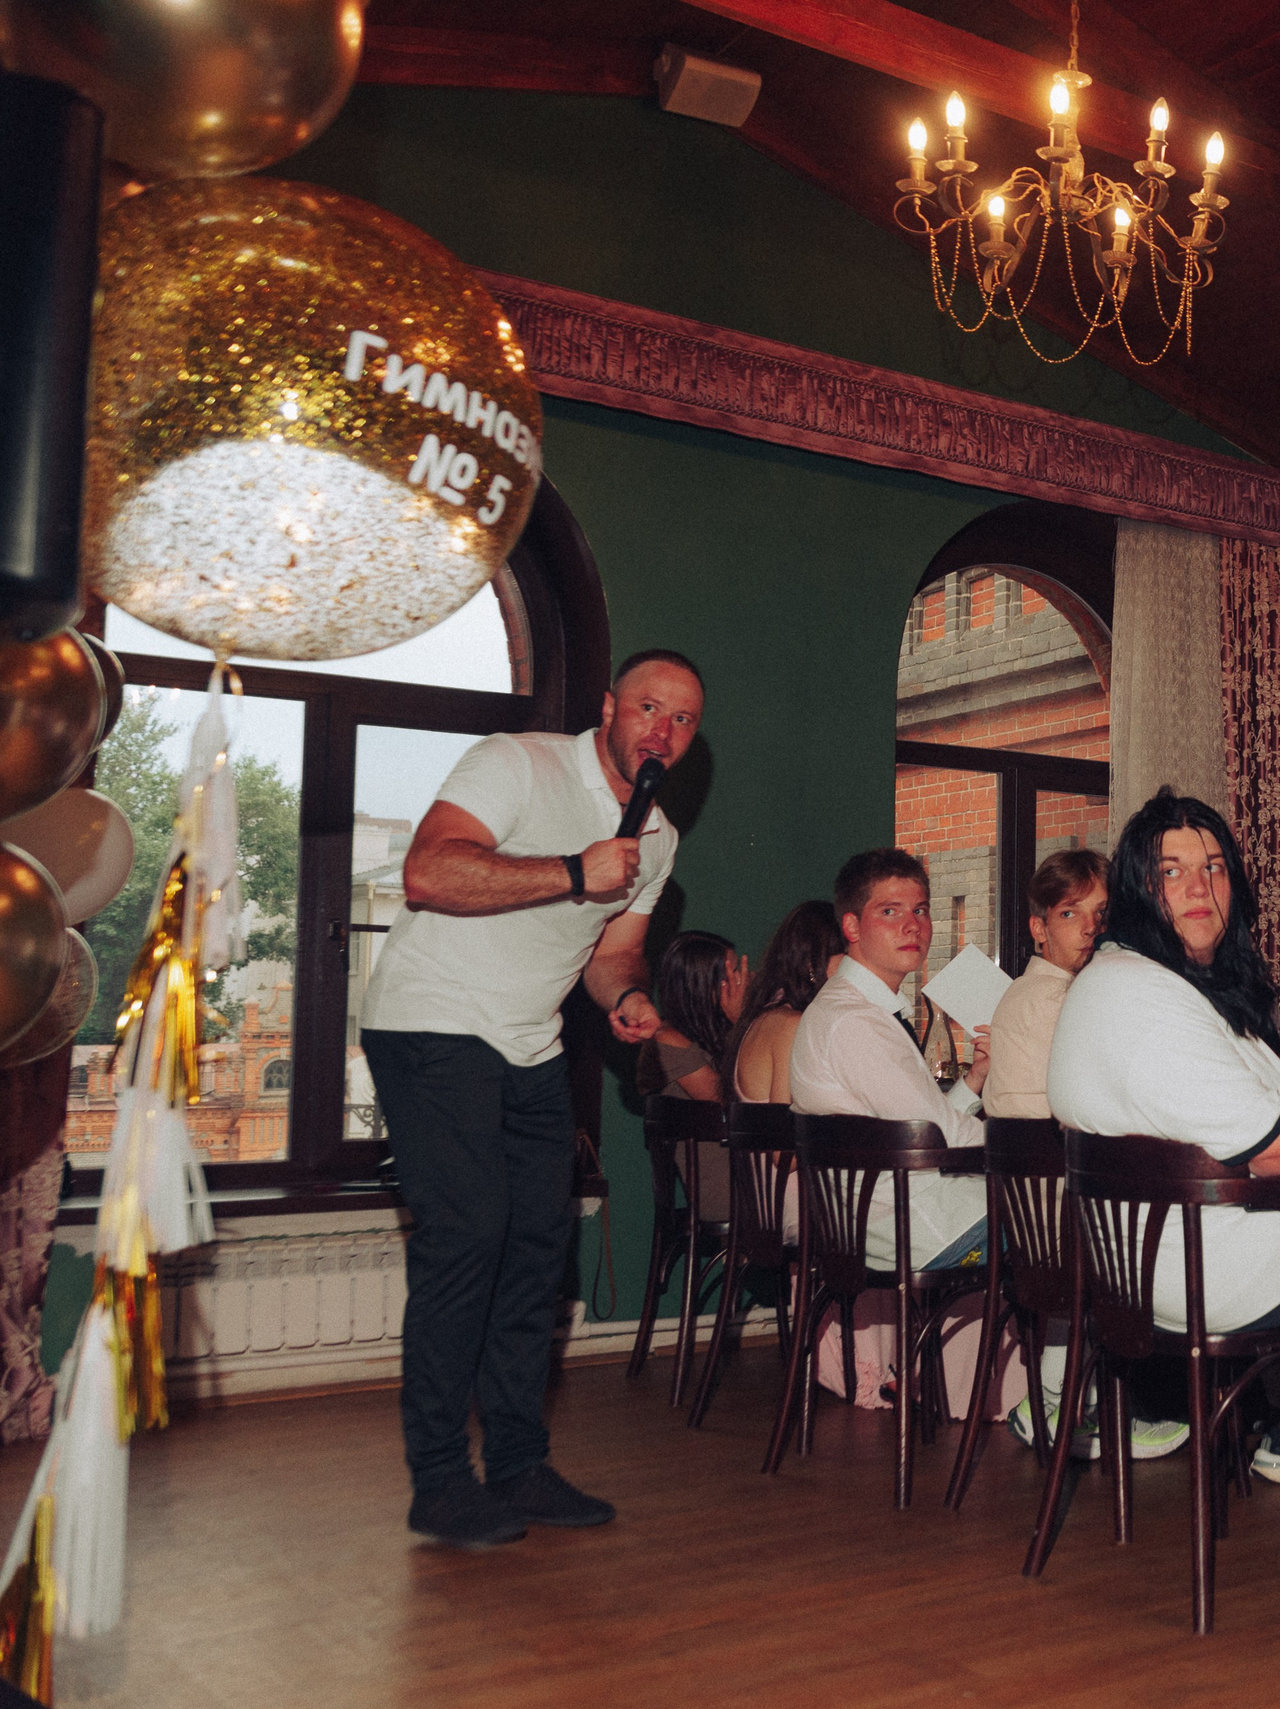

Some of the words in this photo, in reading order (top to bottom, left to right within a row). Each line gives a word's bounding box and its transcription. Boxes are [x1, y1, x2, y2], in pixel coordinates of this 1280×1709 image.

[344, 330, 541, 472] Гимназ
[408, 433, 479, 506] №
[478, 474, 513, 525] 5
